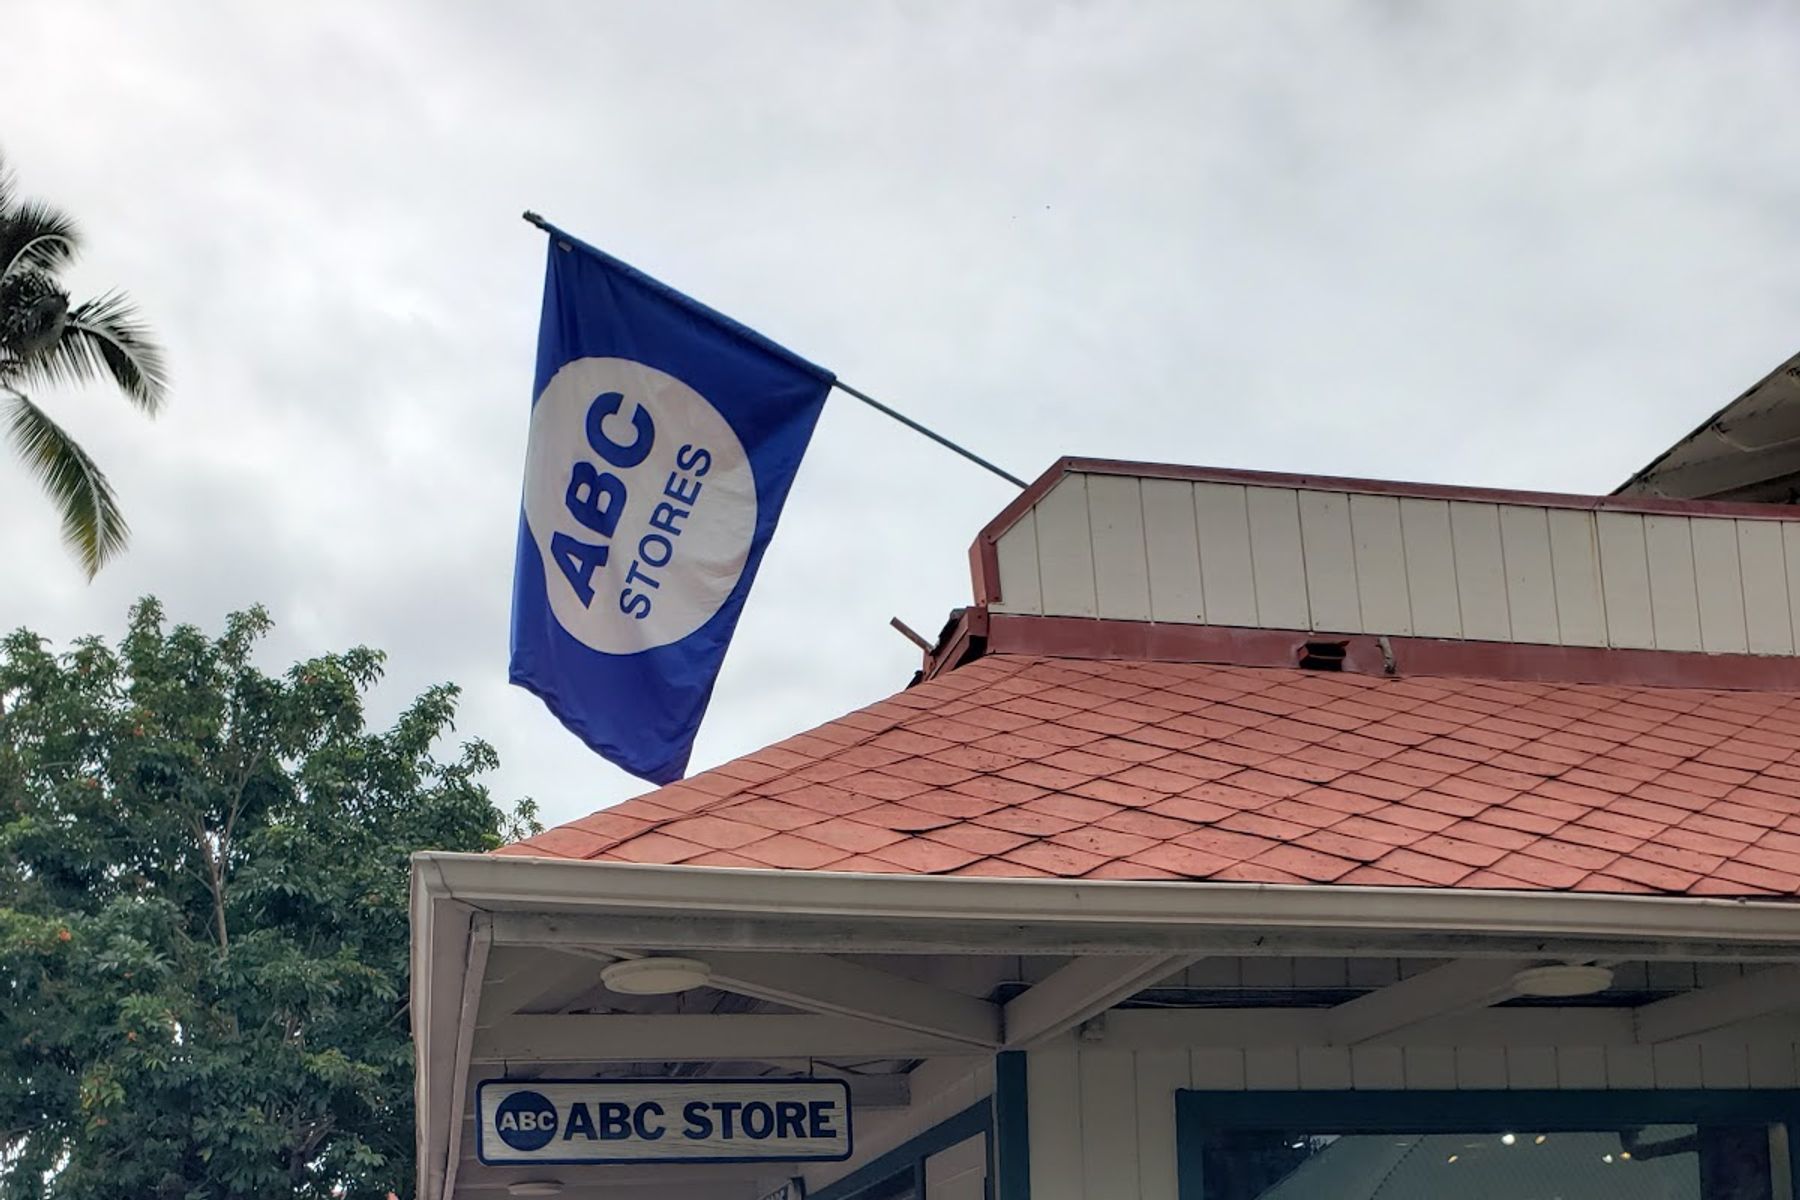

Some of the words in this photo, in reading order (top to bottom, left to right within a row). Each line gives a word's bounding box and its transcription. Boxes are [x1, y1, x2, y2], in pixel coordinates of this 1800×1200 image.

[551, 392, 655, 608] ABC
[619, 443, 713, 620] STORES
[499, 1110, 556, 1132] ABC
[562, 1101, 666, 1141] ABC
[682, 1101, 837, 1140] STORE
